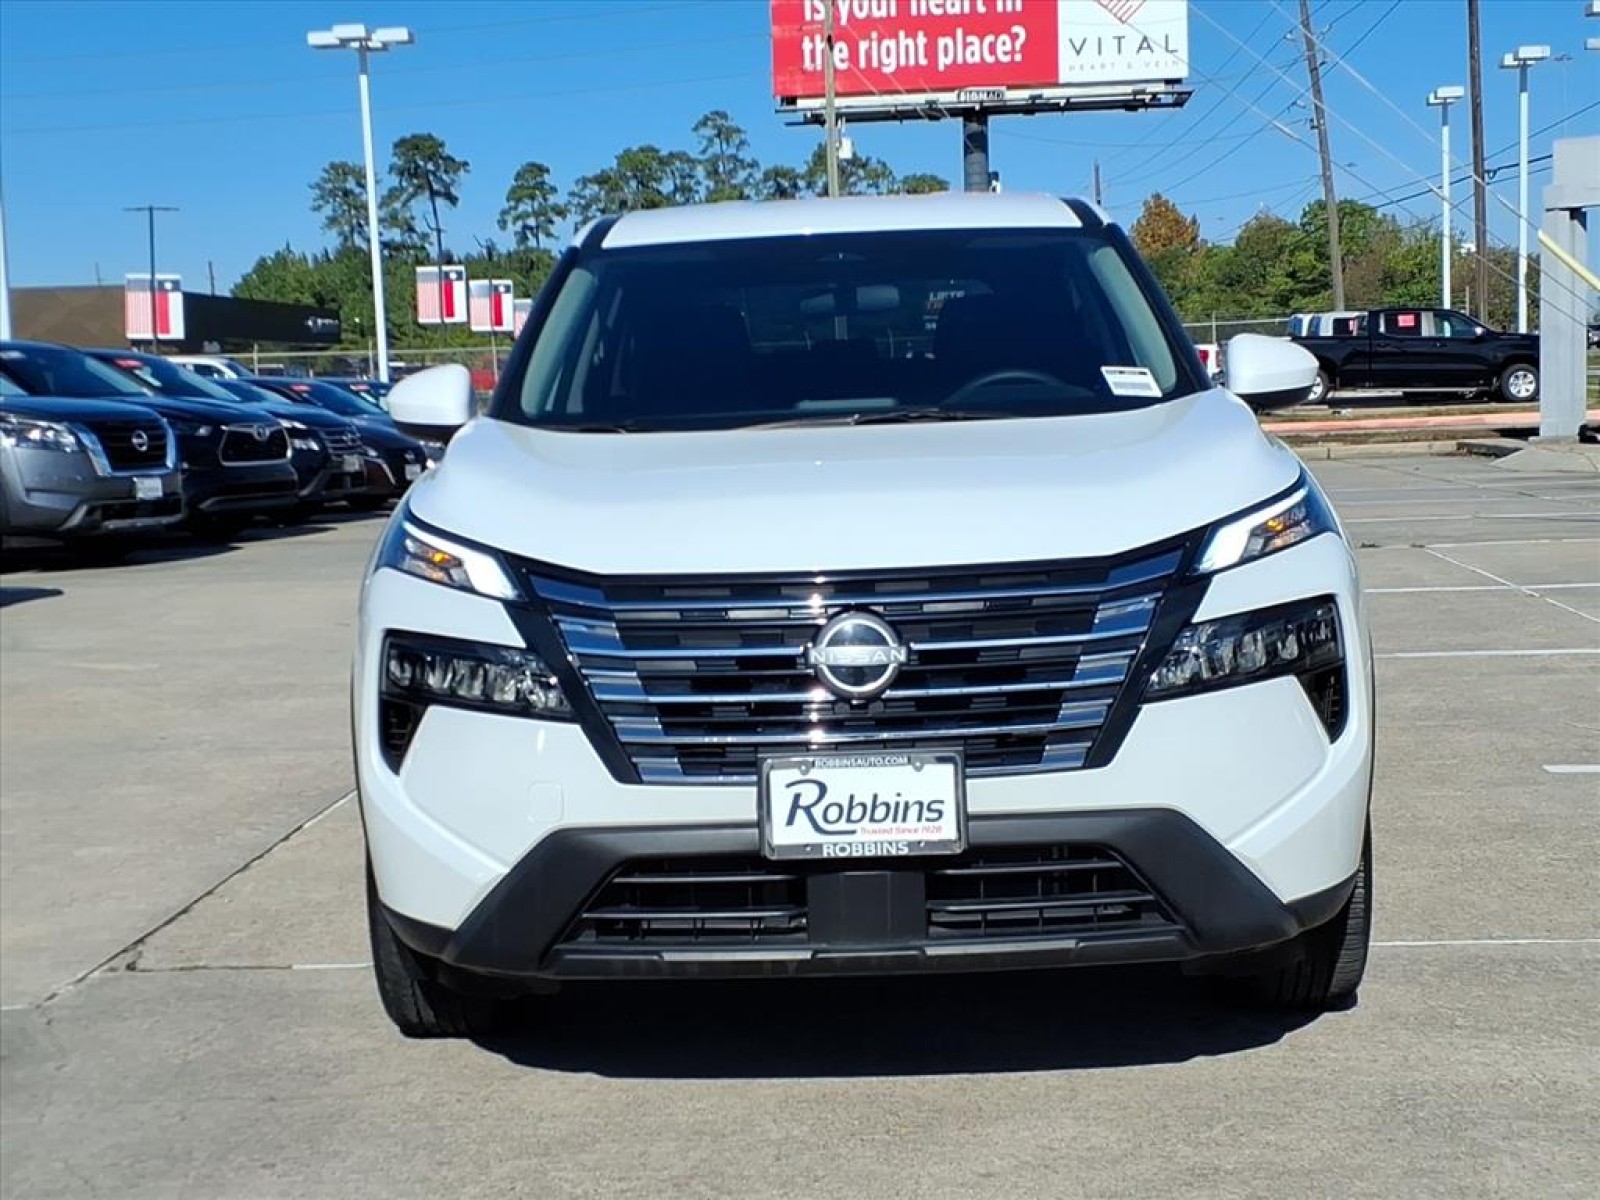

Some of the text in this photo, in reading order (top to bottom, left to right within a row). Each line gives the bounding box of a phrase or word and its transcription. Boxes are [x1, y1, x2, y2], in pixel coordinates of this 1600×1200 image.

[838, 0, 897, 25] your
[802, 25, 1027, 73] the right place?
[1068, 33, 1178, 56] VITAL
[809, 648, 907, 663] NISSAN
[814, 755, 909, 768] ROBBINSAUTO.COM
[785, 778, 945, 836] Robbins
[822, 840, 909, 857] ROBBINS
